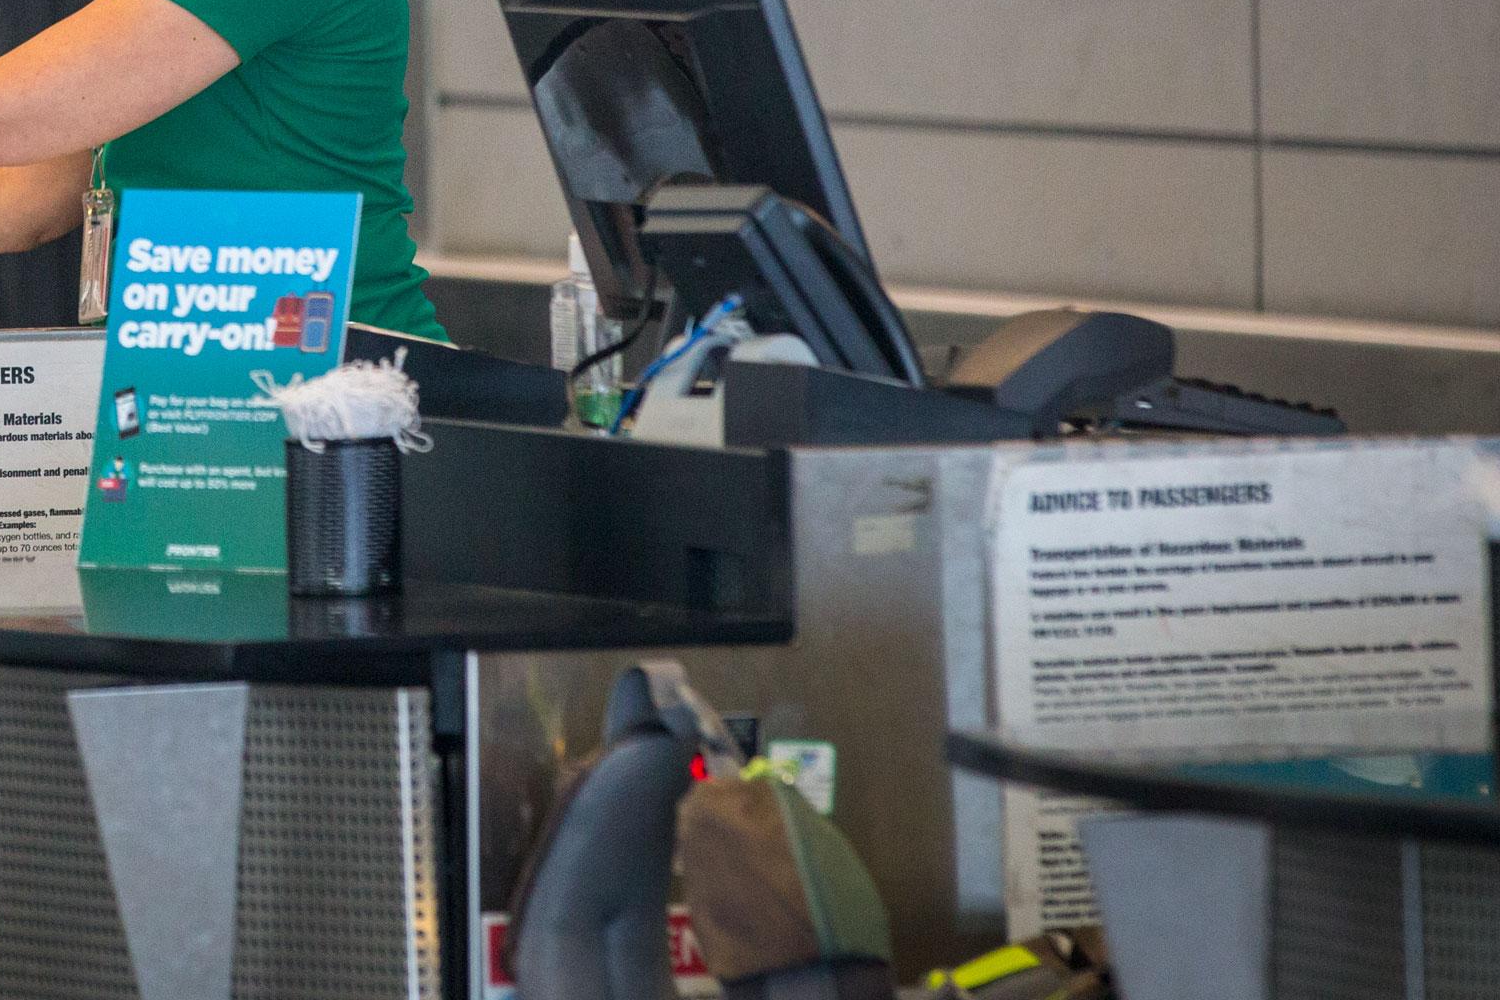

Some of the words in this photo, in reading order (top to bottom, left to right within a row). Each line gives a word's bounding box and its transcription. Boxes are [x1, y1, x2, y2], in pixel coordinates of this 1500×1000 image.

[126, 238, 212, 273] Save
[215, 246, 339, 282] money
[123, 282, 168, 311] on
[172, 284, 257, 318] your
[118, 317, 279, 356] carry-on!
[4, 412, 62, 426] Materials
[31, 431, 73, 441] materials
[76, 431, 93, 440] abo
[43, 467, 61, 477] and
[63, 467, 89, 477] penal
[23, 510, 48, 518] gases,
[49, 508, 84, 516] flammab
[23, 532, 52, 541] bottles,
[56, 531, 74, 540] and
[9, 545, 19, 553] to
[20, 544, 31, 552] 70
[64, 543, 79, 551] tot
